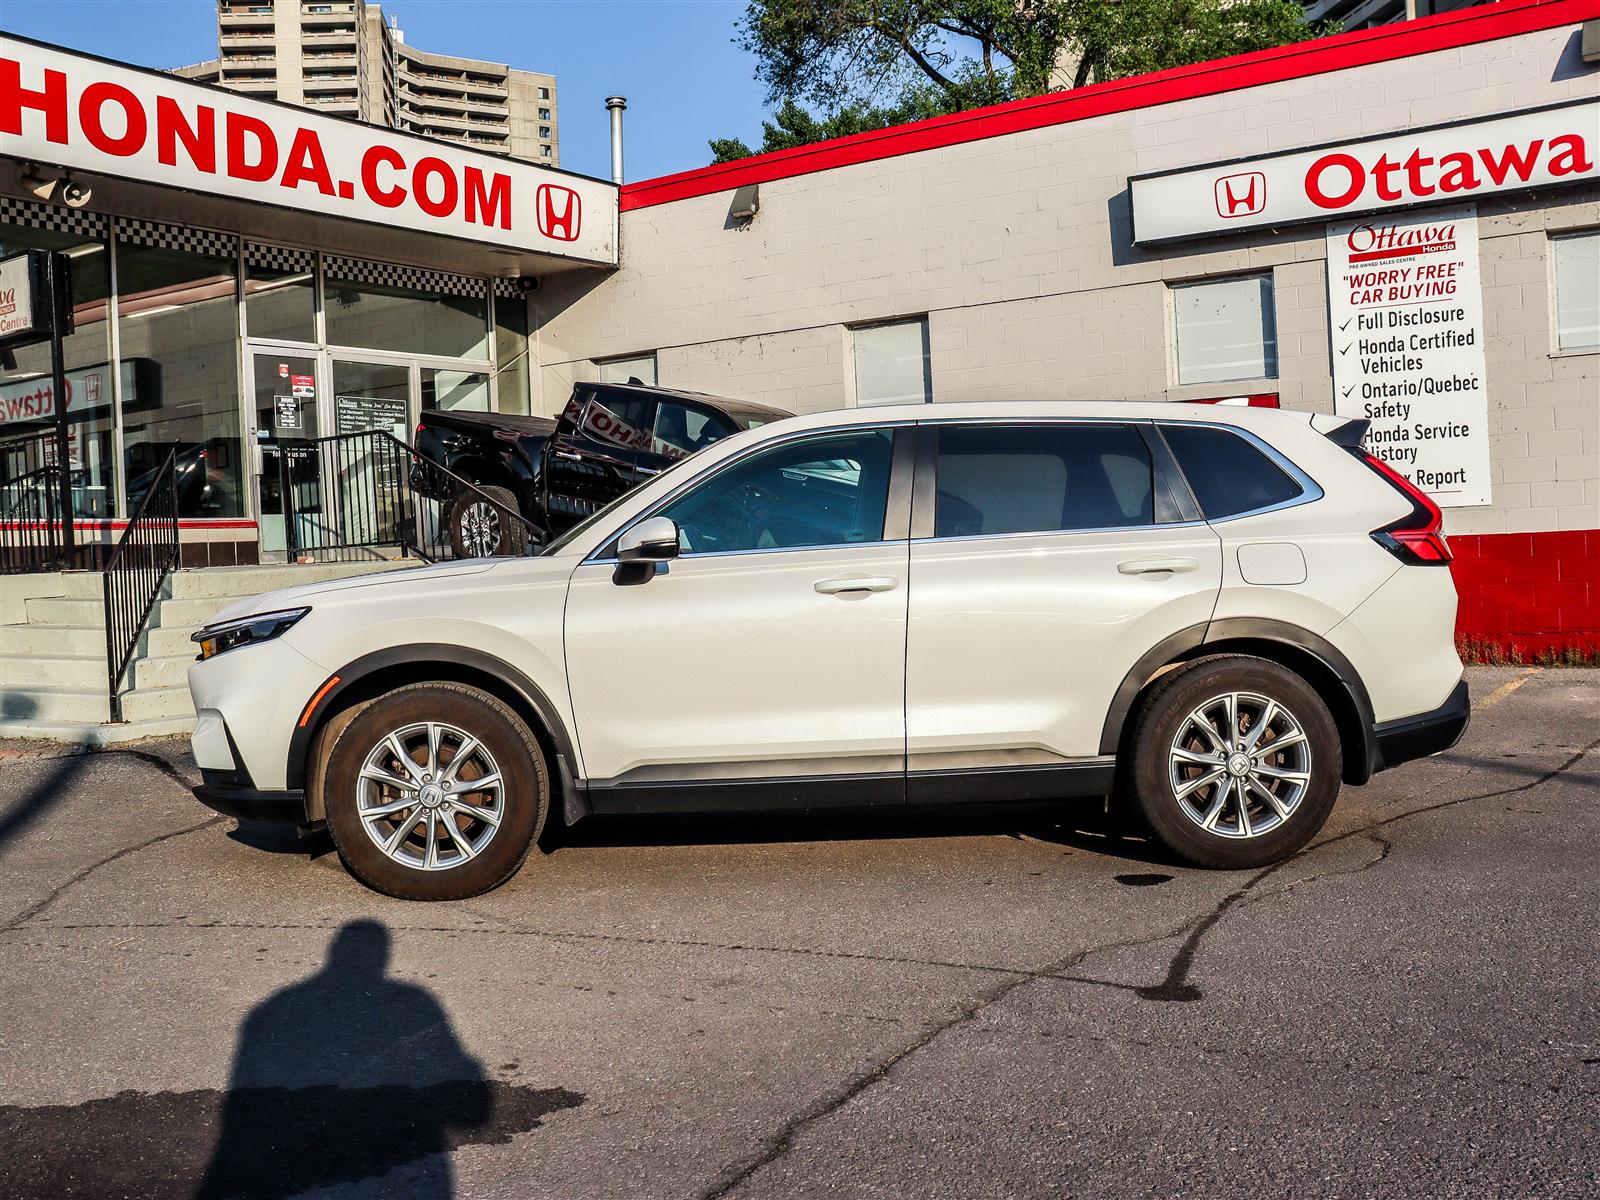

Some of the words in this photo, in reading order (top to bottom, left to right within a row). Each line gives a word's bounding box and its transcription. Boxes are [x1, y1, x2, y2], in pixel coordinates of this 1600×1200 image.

[0, 58, 512, 230] HONDA.COM
[1304, 133, 1593, 209] Ottawa
[1347, 222, 1456, 253] Ottawa
[1422, 243, 1455, 254] Honda
[1343, 268, 1411, 289] "WORRY
[1416, 261, 1464, 281] FREE"
[1348, 261, 1379, 270] PRE-OWNED
[1379, 259, 1396, 267] SALES
[1395, 256, 1416, 264] CENTRE
[1350, 288, 1383, 306] CAR
[1388, 279, 1457, 301] BUYING
[1358, 312, 1383, 331] Full
[1388, 308, 1465, 328] Disclosure
[1359, 335, 1405, 355] Honda
[1409, 328, 1475, 349] Certified
[1361, 354, 1423, 374] Vehicles
[1362, 374, 1479, 399] Ontario/Quebec
[1364, 402, 1411, 421] Safety
[1365, 425, 1410, 444] Honda
[1414, 421, 1470, 440] Service
[1416, 468, 1467, 489] Report
